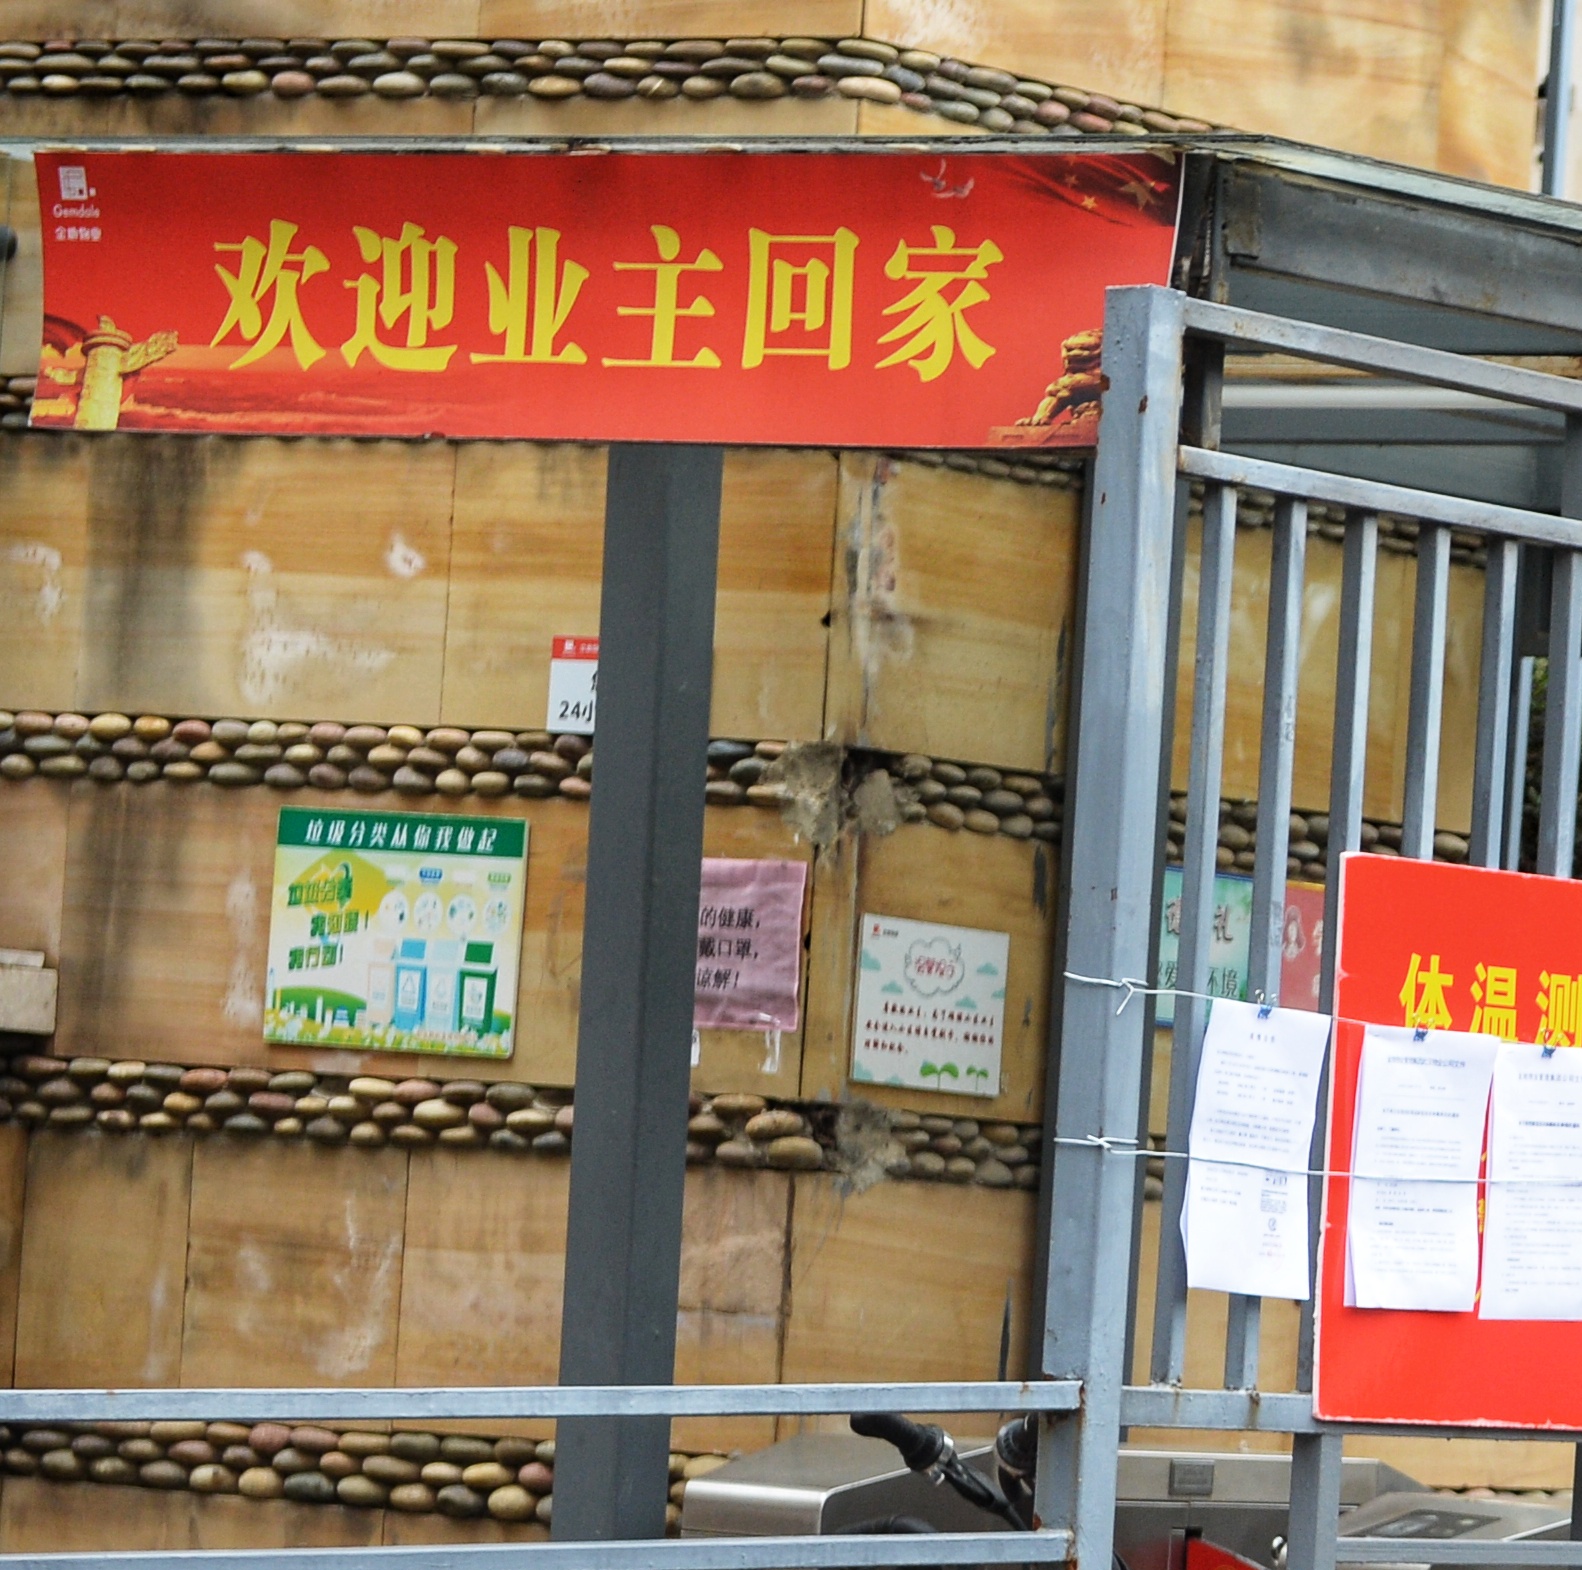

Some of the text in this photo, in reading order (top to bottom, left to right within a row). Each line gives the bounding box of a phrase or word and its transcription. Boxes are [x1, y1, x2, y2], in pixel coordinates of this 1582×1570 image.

[210, 219, 1004, 382] 欢迎业主回家
[305, 818, 498, 854] 垃圾分类从你我做起
